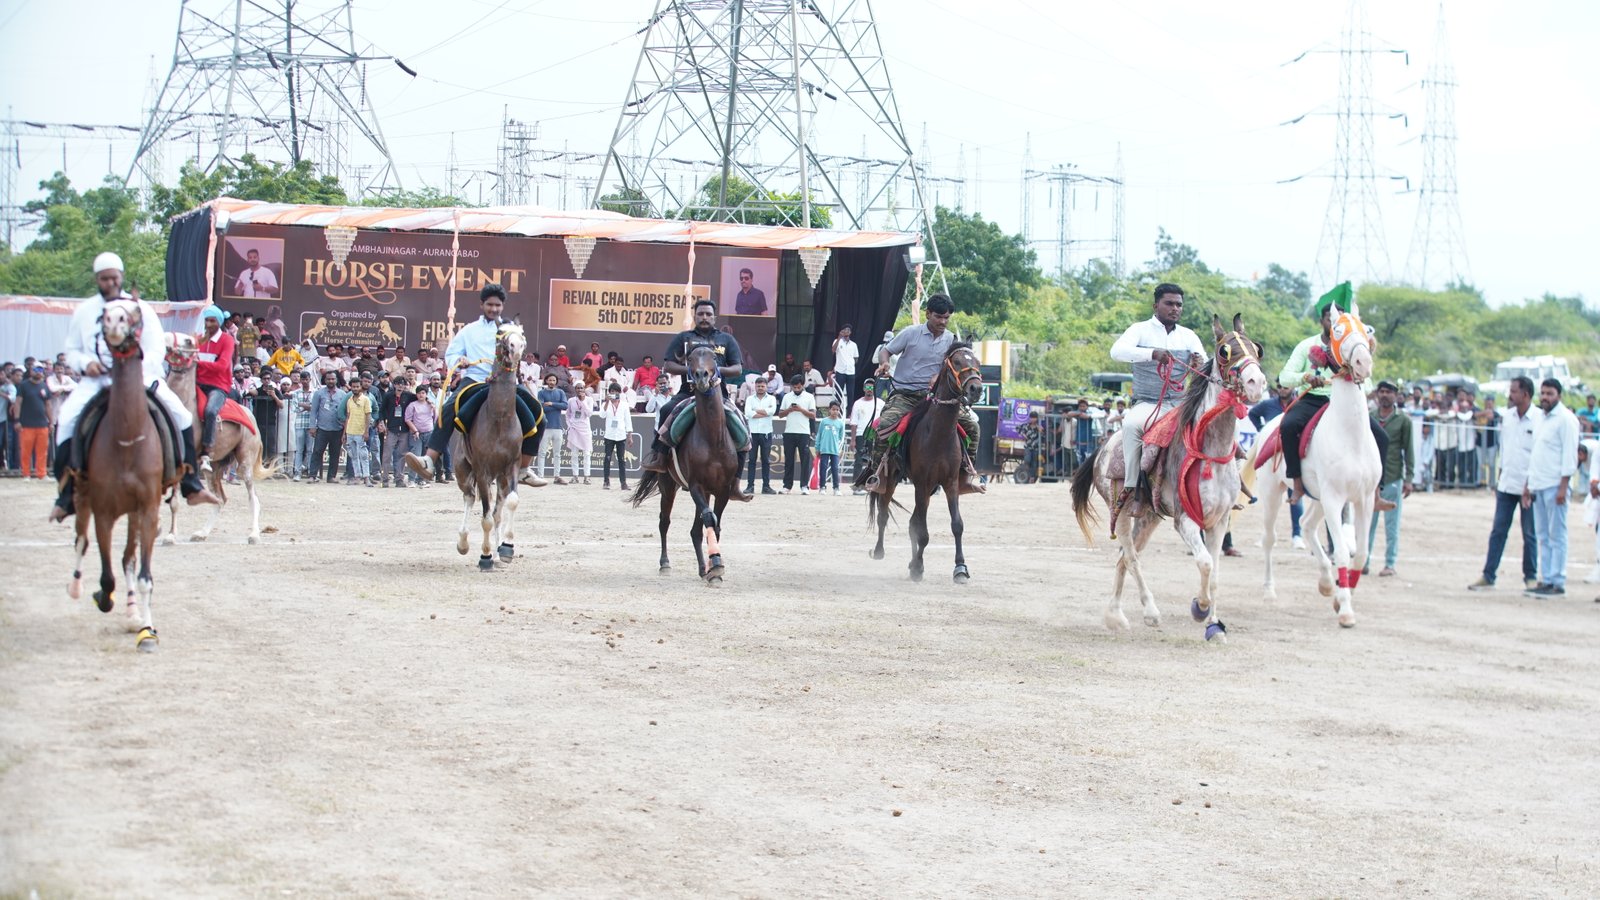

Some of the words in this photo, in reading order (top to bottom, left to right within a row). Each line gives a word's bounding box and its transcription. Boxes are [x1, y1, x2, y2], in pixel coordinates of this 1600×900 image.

[352, 244, 416, 256] AMBHAJINAGAR
[303, 258, 405, 305] HORSE
[411, 265, 527, 293] EVENT
[562, 290, 598, 305] REVAL
[602, 291, 631, 307] CHAL
[634, 293, 670, 308] HORSE
[331, 309, 367, 320] Organized
[368, 311, 377, 321] by
[598, 309, 617, 323] 5th
[621, 310, 643, 324] OCT
[645, 311, 673, 326] 2025
[422, 321, 465, 341] FIRT
[324, 336, 344, 344] Horse
[345, 337, 381, 346] Committee
